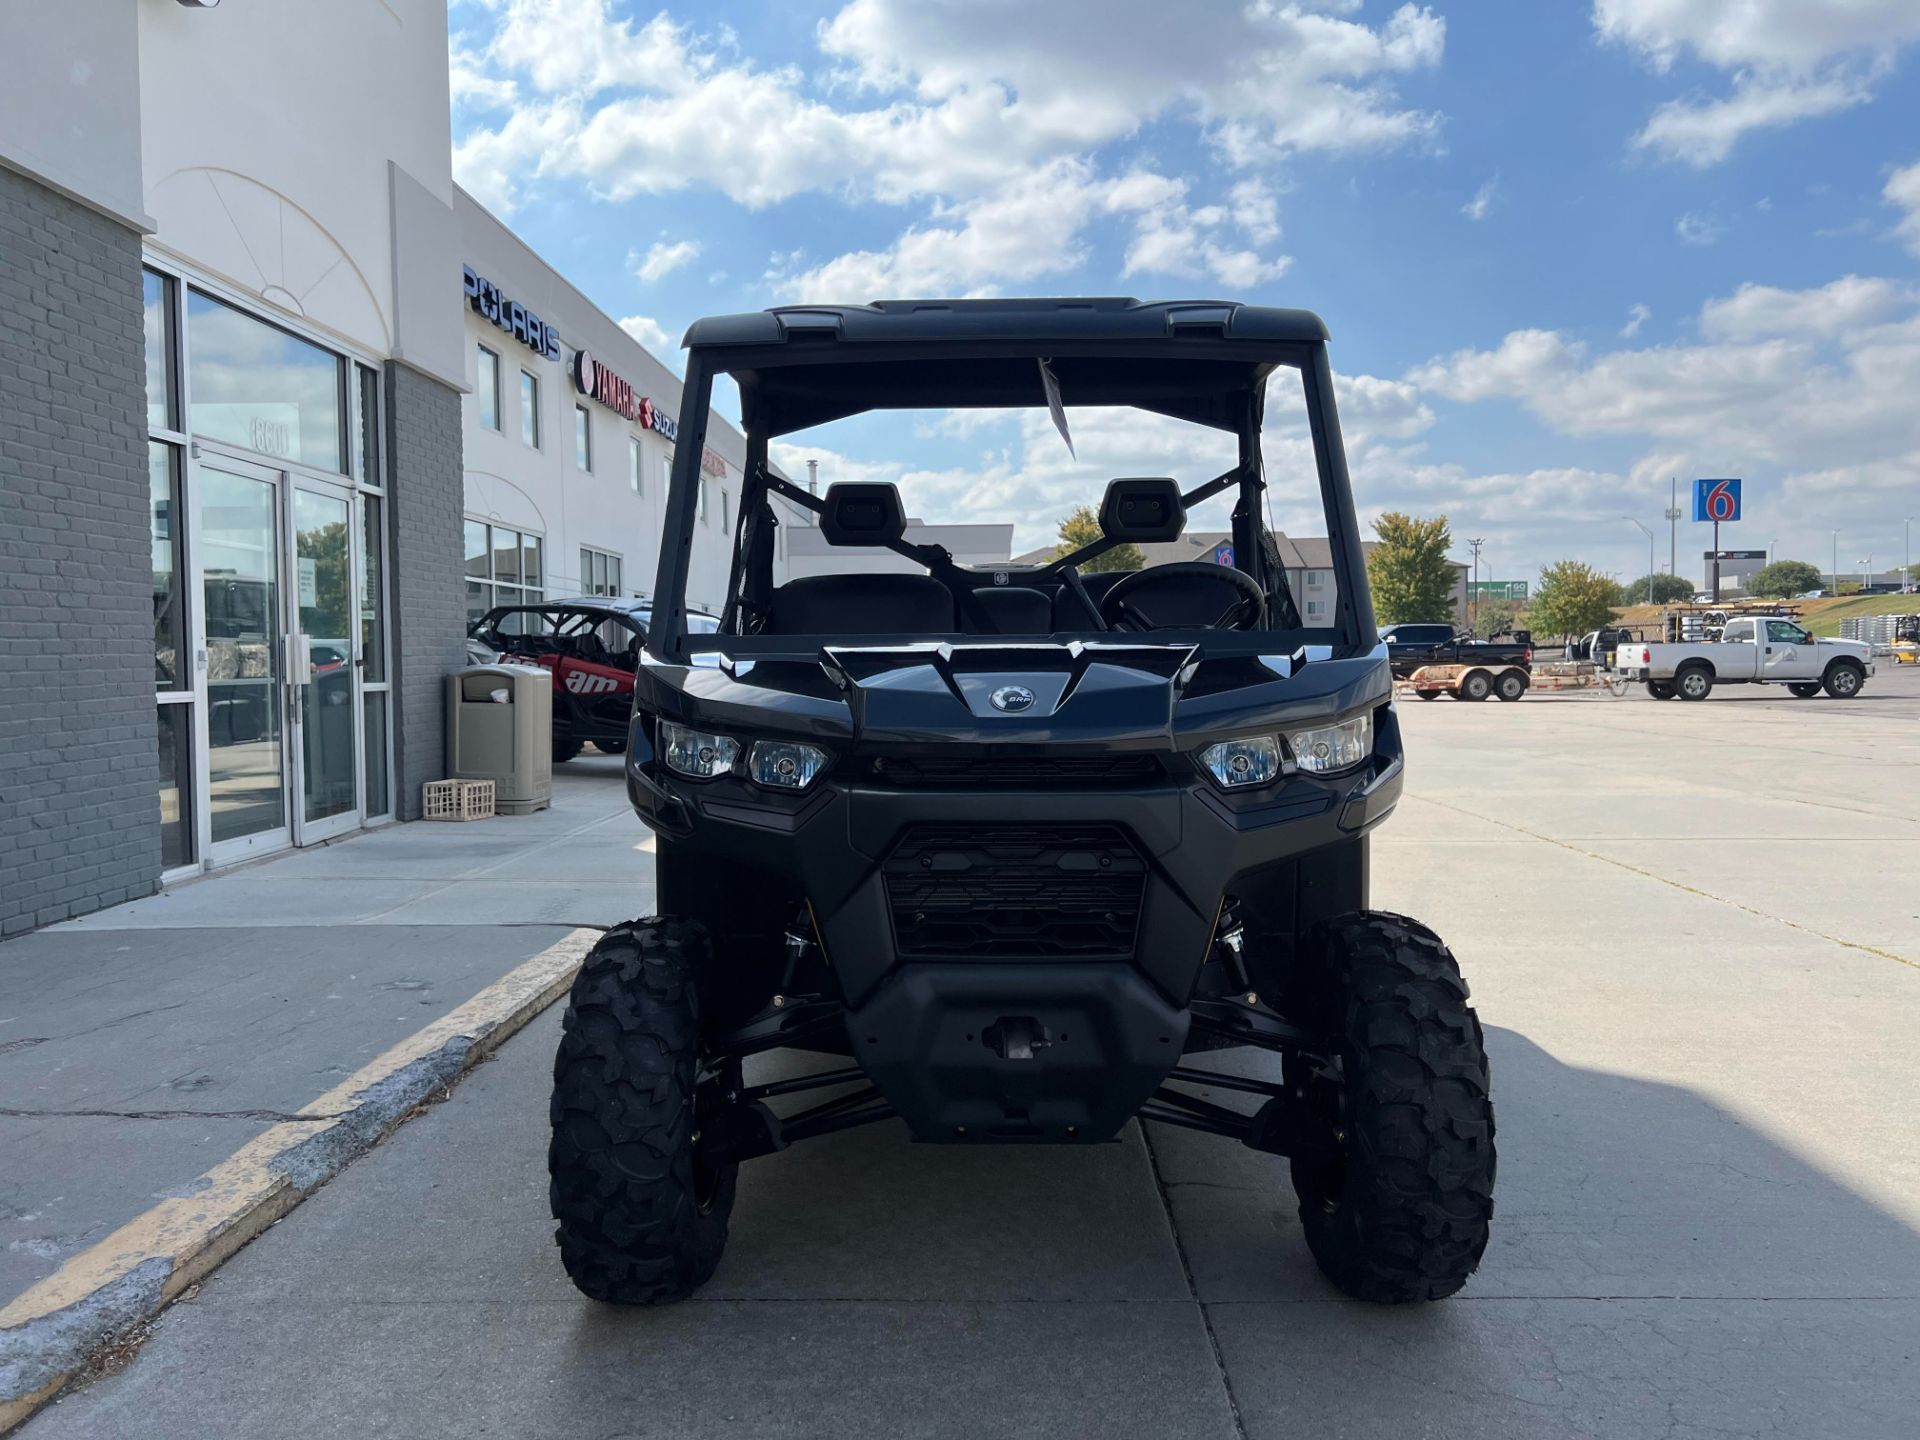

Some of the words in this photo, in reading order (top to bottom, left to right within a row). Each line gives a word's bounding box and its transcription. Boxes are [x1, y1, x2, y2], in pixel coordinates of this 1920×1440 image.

[463, 263, 560, 361] POLARIS
[596, 361, 635, 421] YAMAHA
[653, 409, 678, 443] SUZU
[1706, 480, 1735, 520] 6
[1219, 550, 1232, 568] 6
[565, 670, 619, 694] am
